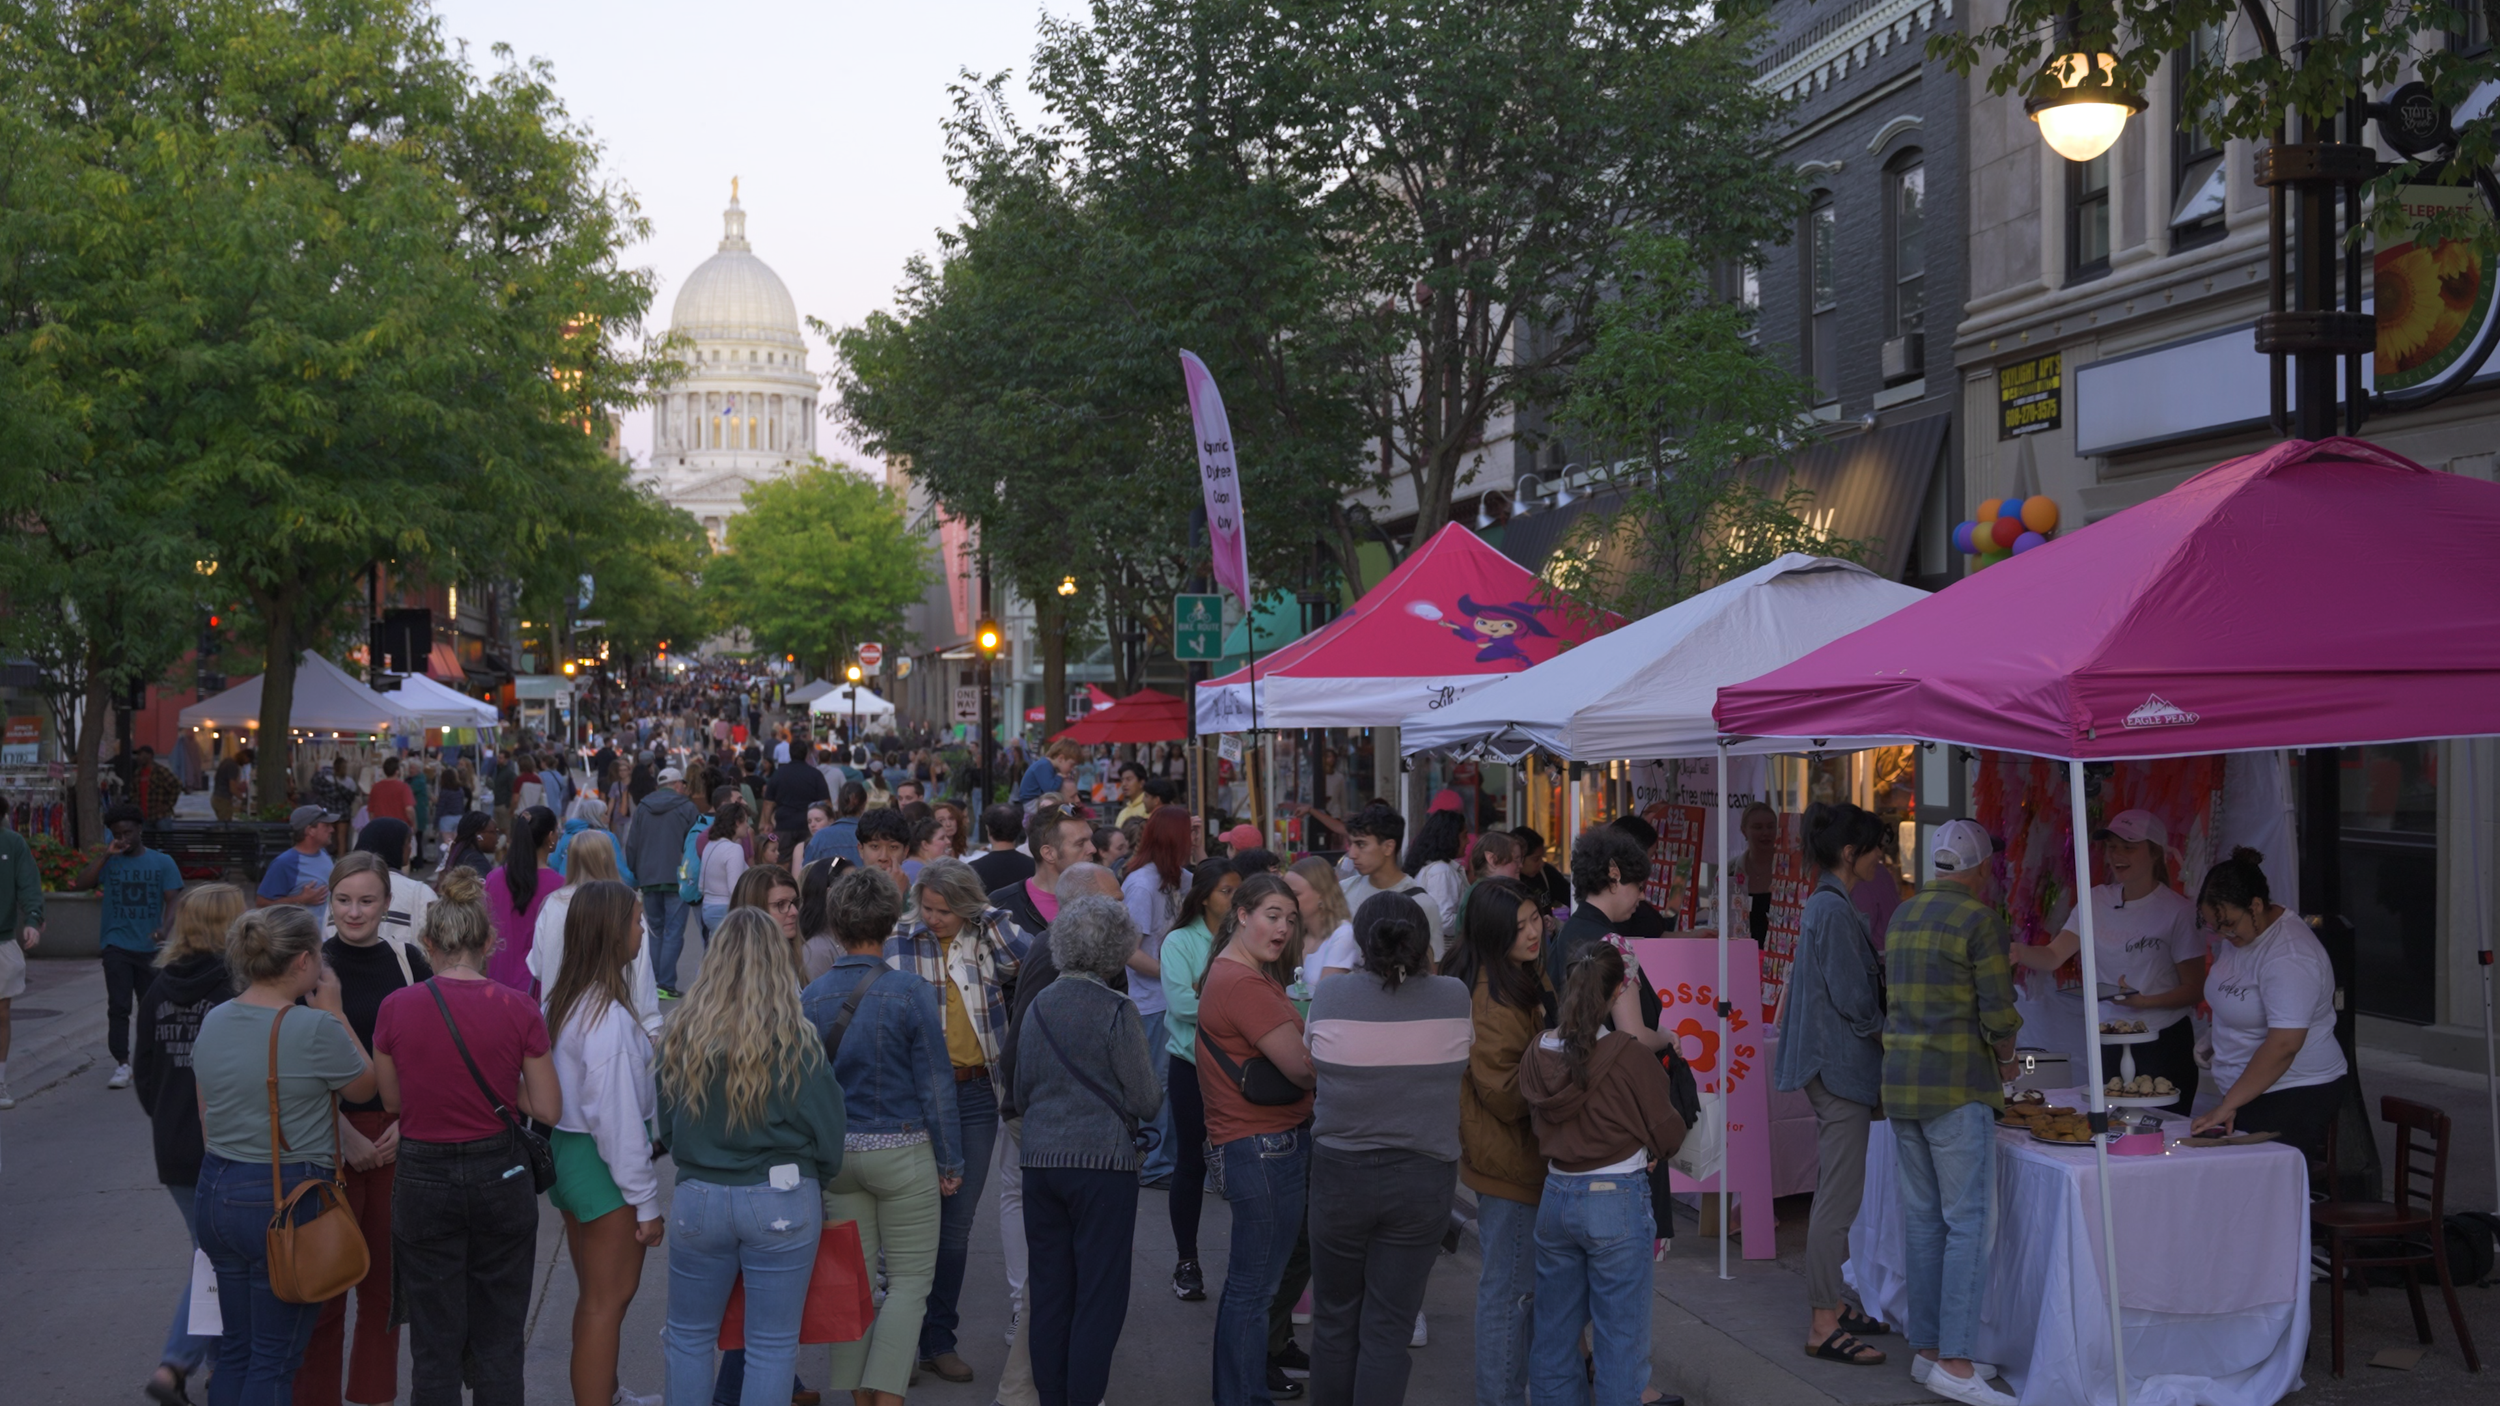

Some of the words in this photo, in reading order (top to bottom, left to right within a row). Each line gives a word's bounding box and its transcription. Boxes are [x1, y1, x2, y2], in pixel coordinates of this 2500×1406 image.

[2400, 104, 2432, 120] STATE
[2401, 118, 2432, 131] Street
[2393, 314, 2481, 387] CELEBRATE
[2000, 361, 2036, 389] SKYLIGHT
[2005, 398, 2057, 428] 608-270-3575
[1178, 622, 1194, 631] BIKE
[1197, 622, 1220, 631] ROUTE
[957, 690, 976, 699] ONE
[957, 699, 976, 709] WAY
[2127, 716, 2161, 726] EAGLE
[2164, 713, 2194, 724] PEAK
[1222, 736, 1240, 750] ORDER
[1667, 807, 1686, 825] $25
[123, 869, 162, 881] TRUE
[2125, 935, 2161, 953] bakes
[2218, 976, 2250, 1001] bakes
[155, 1024, 183, 1042] FIFTY
